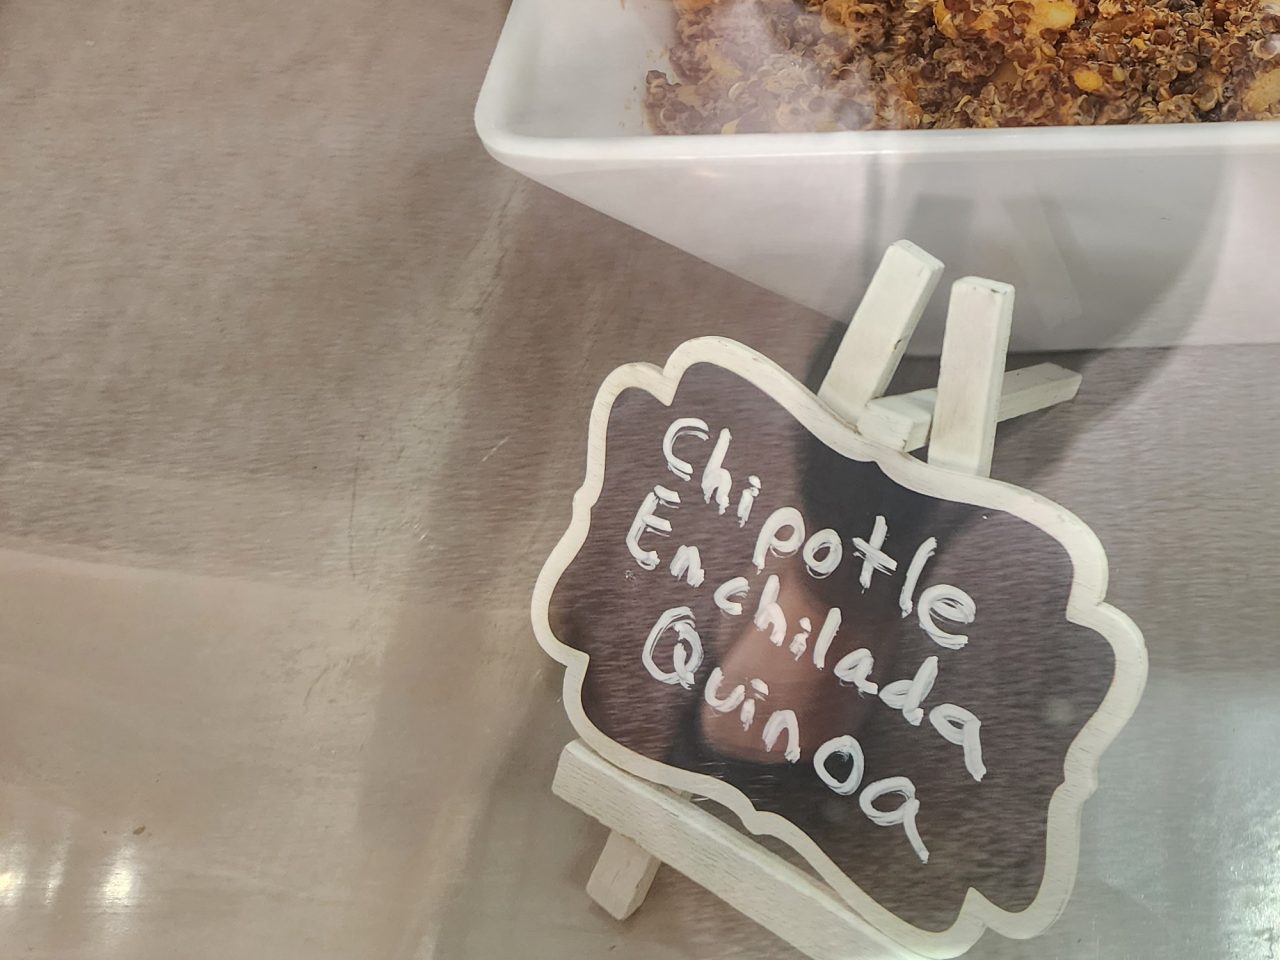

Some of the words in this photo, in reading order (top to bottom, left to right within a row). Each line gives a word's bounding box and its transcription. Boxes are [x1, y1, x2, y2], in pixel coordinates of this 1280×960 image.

[625, 485, 986, 782] Enchilada
[662, 417, 977, 648] Chipotle
[641, 606, 930, 864] Quinoa
